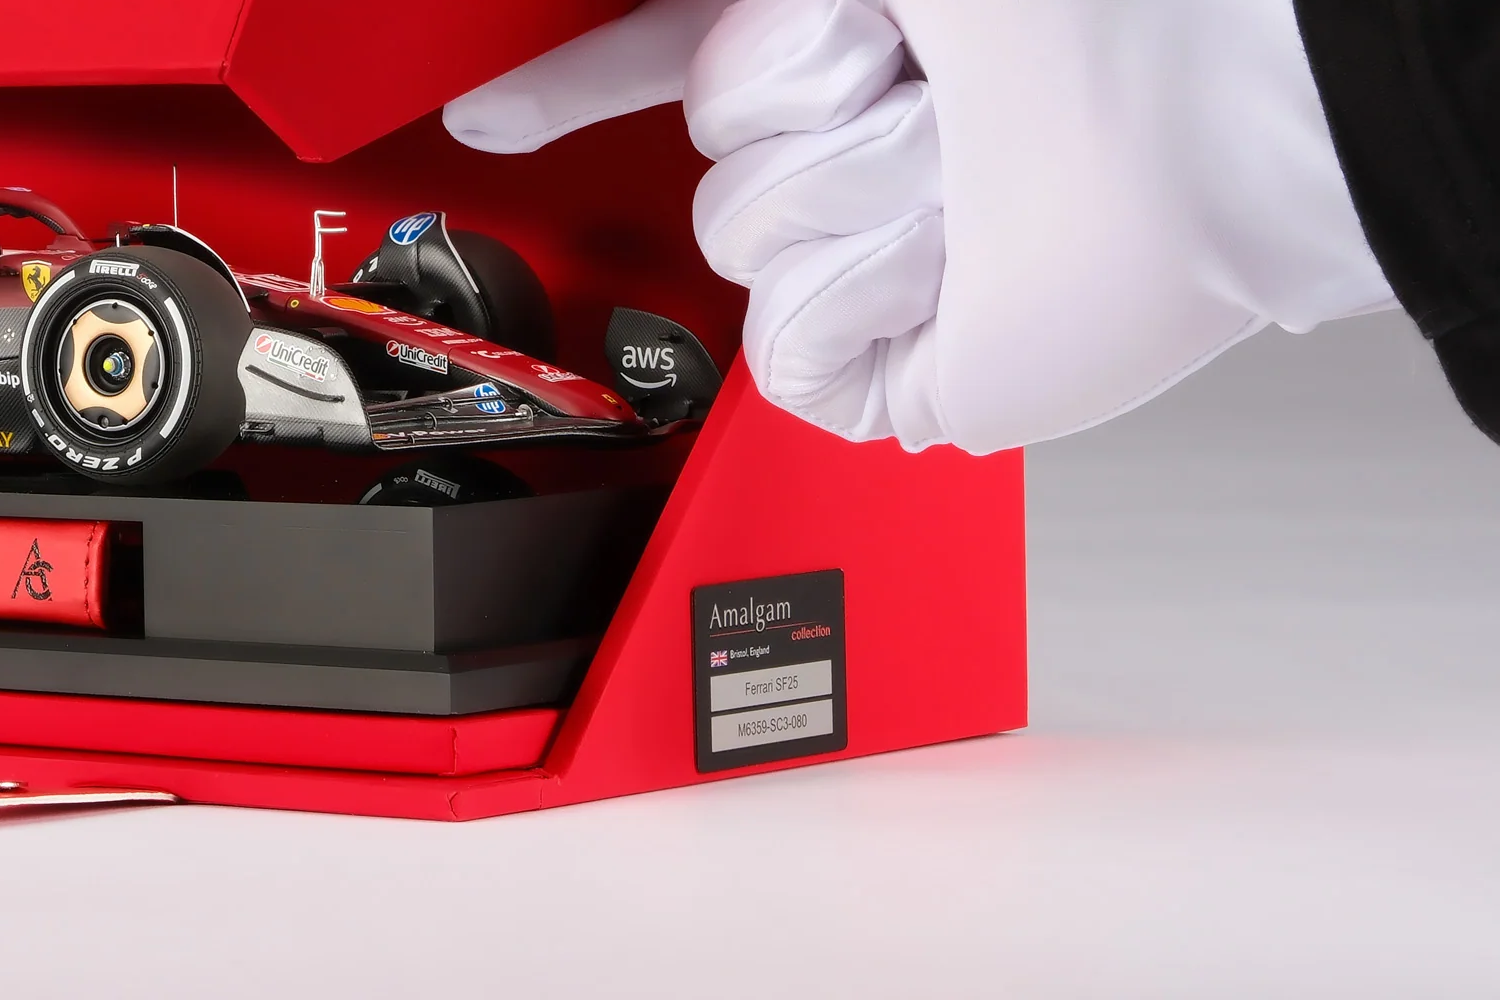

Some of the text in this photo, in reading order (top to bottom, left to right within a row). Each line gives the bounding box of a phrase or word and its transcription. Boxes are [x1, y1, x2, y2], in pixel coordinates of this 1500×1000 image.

[89, 260, 140, 277] PIRELLI
[271, 341, 329, 376] UniCredit
[400, 343, 448, 369] UniCredit
[622, 346, 675, 370] aws
[46, 433, 142, 471] P ZERO
[709, 597, 791, 632] Amalgam
[791, 625, 831, 640] collection
[749, 645, 770, 658] England
[745, 675, 799, 696] Ferrari SF25
[738, 713, 808, 737] M6359-SC3-080
